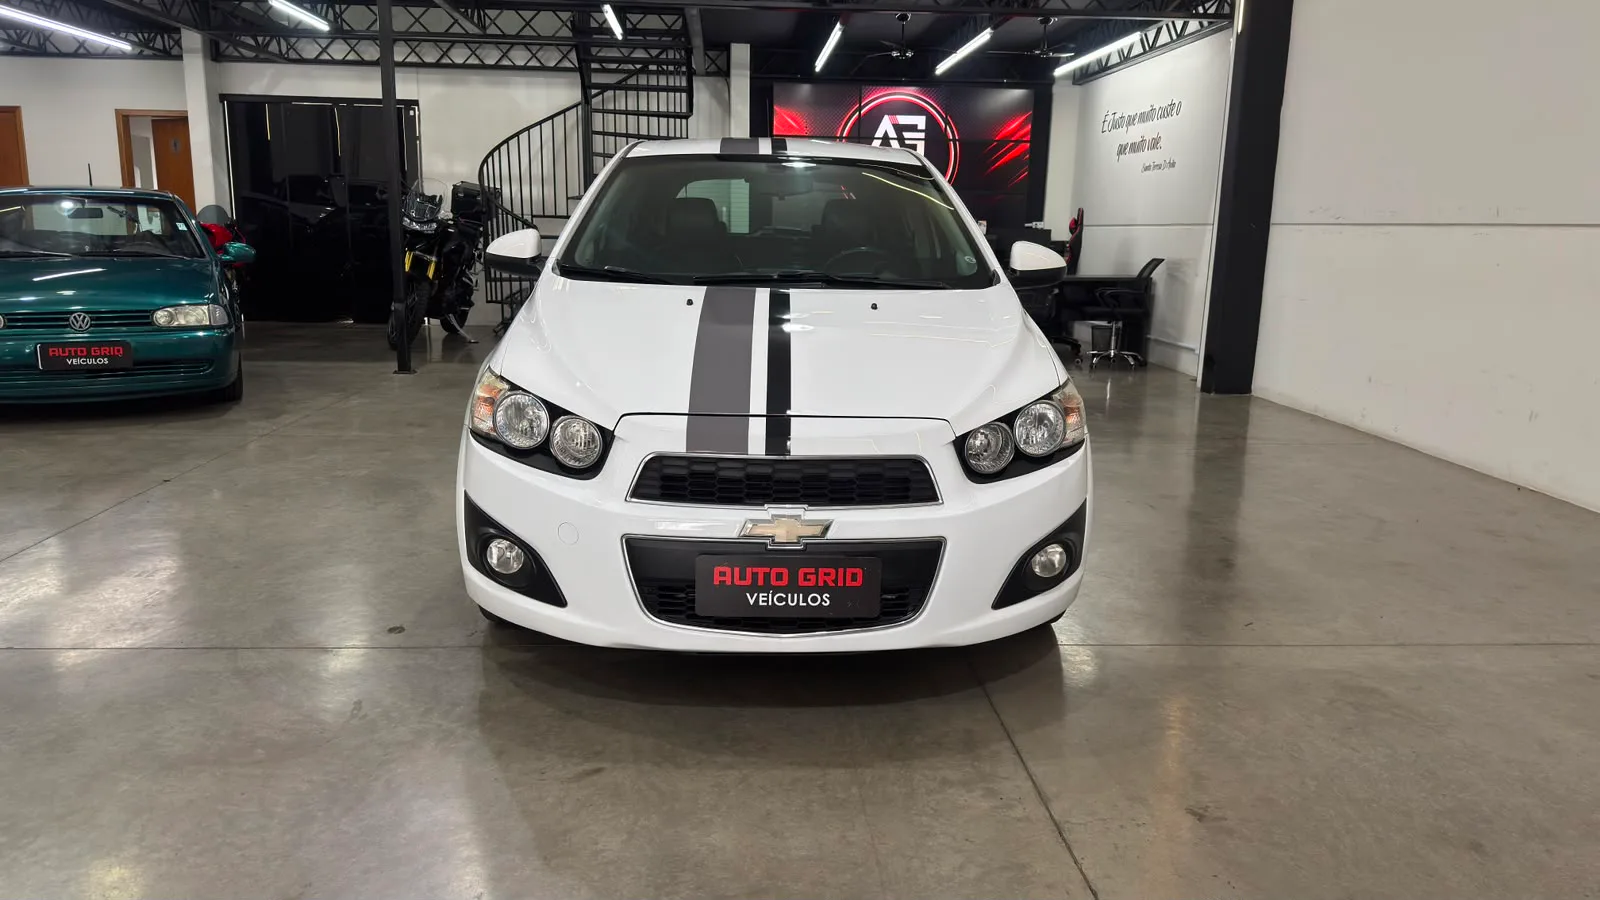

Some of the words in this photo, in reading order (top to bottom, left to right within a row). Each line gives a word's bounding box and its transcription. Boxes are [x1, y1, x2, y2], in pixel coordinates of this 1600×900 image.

[1101, 110, 1109, 133] É
[1125, 112, 1138, 134] que
[1137, 104, 1157, 124] muito
[1156, 99, 1176, 120] custe
[1175, 100, 1182, 116] o
[1116, 142, 1129, 162] que
[1128, 135, 1147, 154] muito
[1146, 132, 1162, 151] vale.
[48, 346, 87, 357] AUTO
[91, 346, 123, 357] GRID
[66, 357, 109, 365] VEÍCULOS
[713, 566, 789, 587] AUTO
[797, 567, 863, 587] GRID
[746, 590, 830, 606] VEÍCULOS
